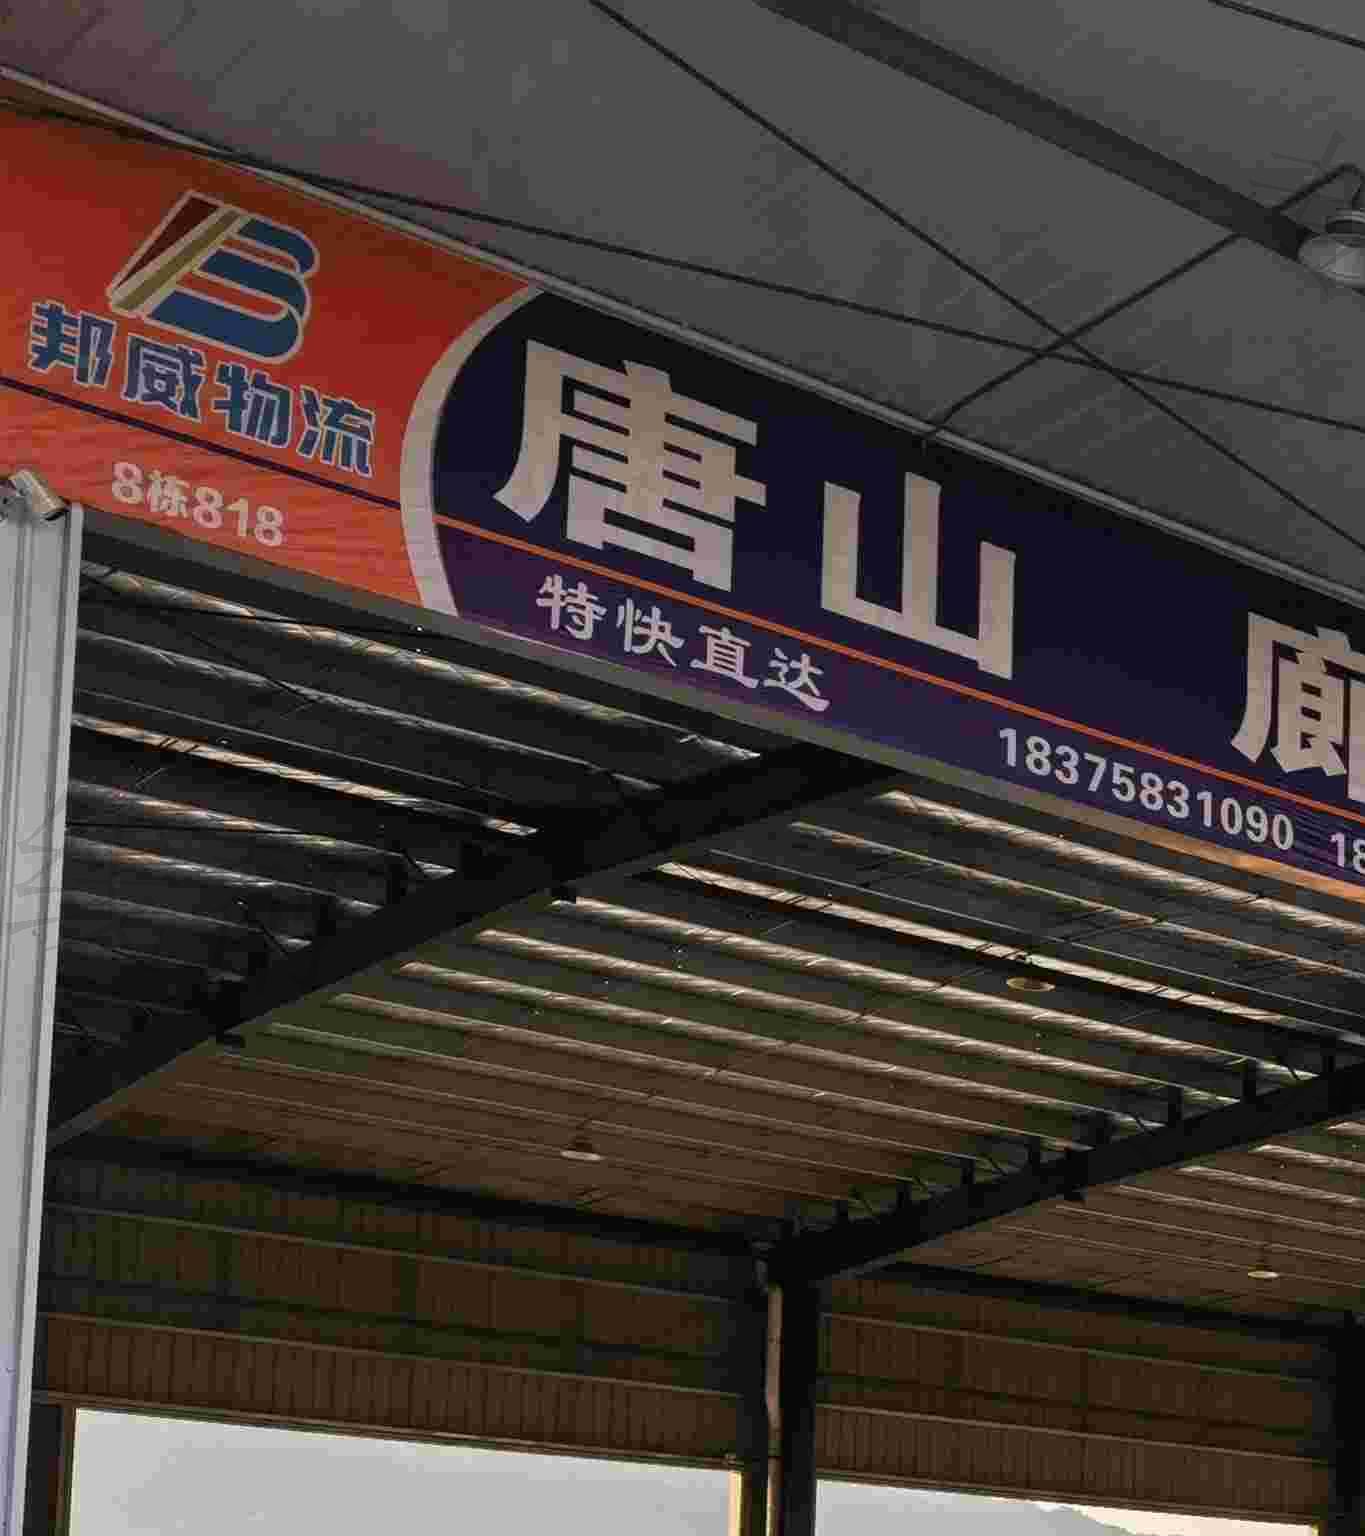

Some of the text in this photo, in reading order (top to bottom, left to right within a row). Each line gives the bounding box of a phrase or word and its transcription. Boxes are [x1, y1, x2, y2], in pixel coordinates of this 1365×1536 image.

[26, 299, 378, 478] 邦威物流
[112, 462, 284, 548] 8栋818
[492, 338, 1016, 681] 唐山
[536, 575, 831, 712] 特快直达
[998, 728, 1295, 852] 18375831090
